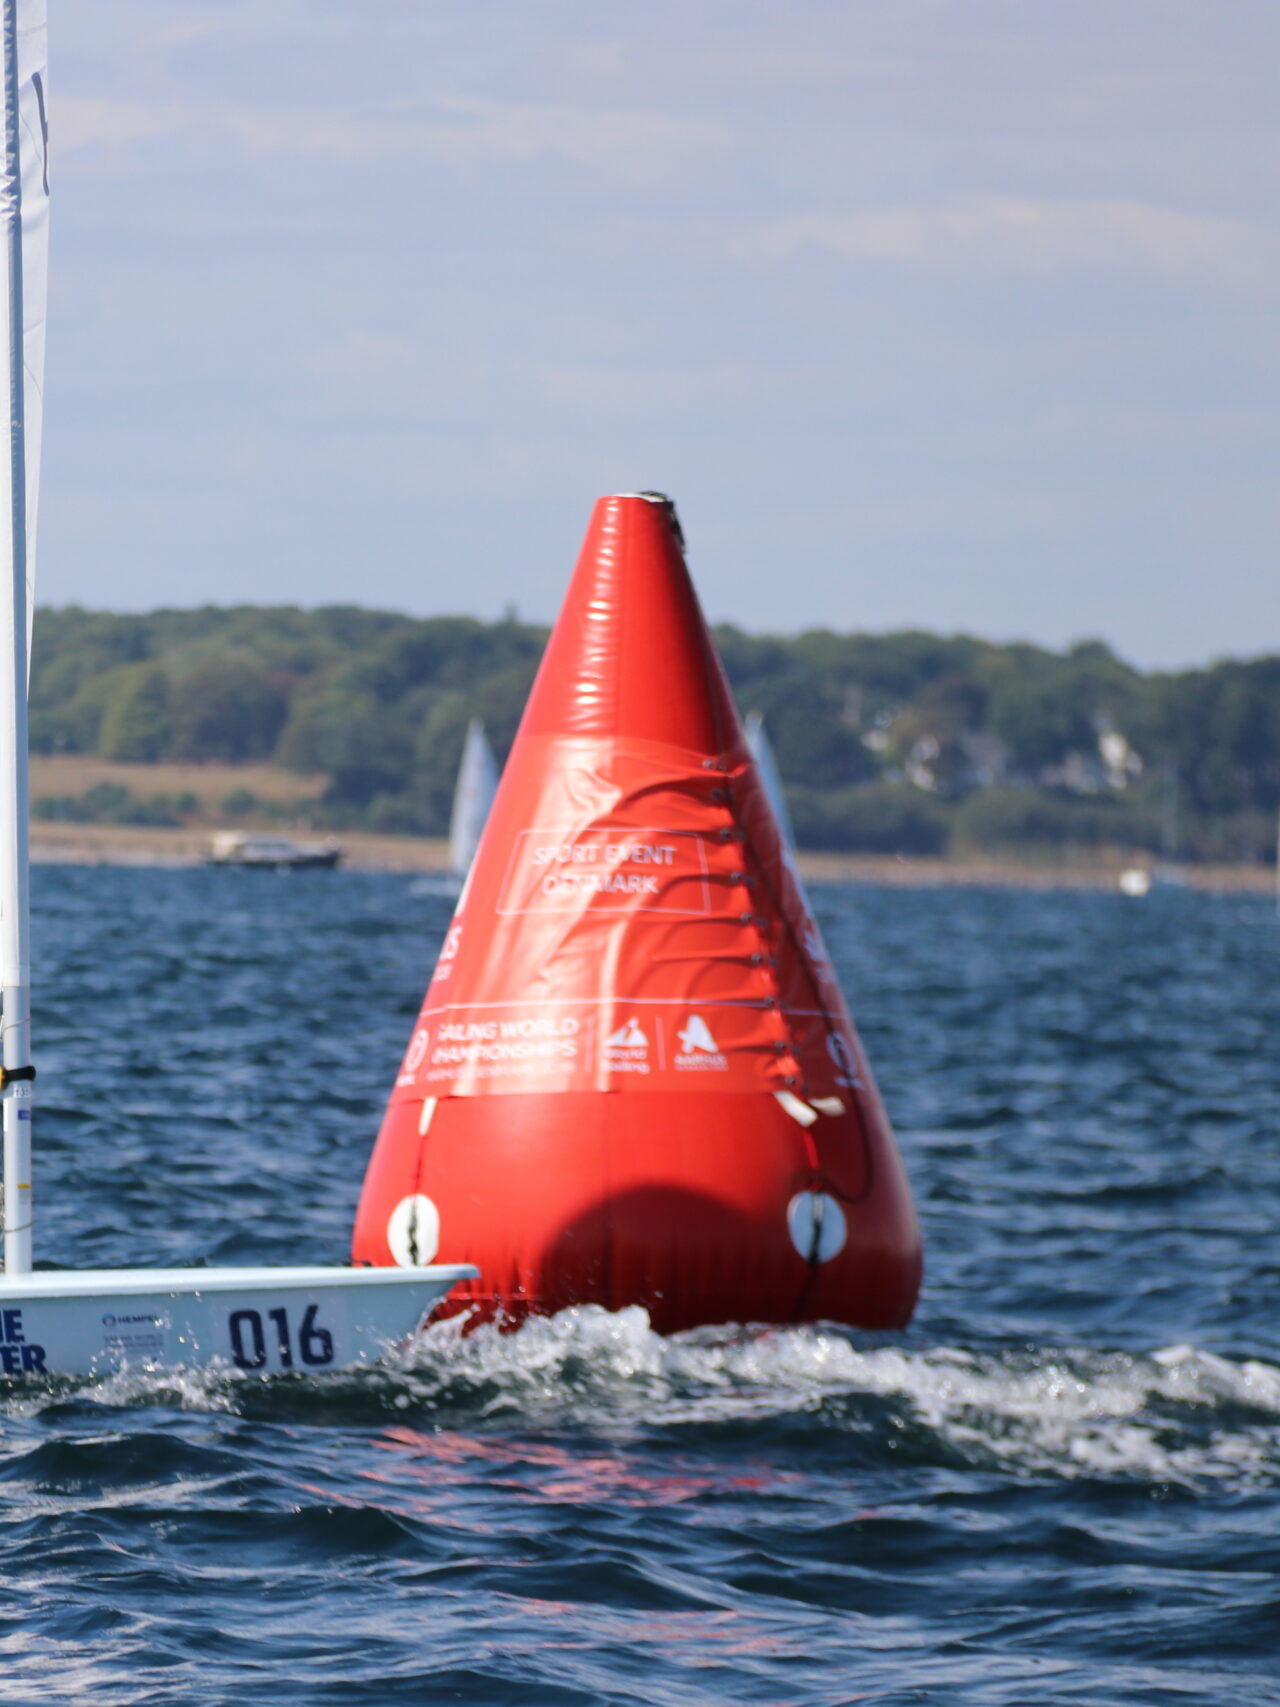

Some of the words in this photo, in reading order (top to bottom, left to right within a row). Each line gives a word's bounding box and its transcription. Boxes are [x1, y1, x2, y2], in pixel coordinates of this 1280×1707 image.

[532, 845, 599, 865] SPORT
[604, 844, 677, 865] EVENT
[500, 1018, 580, 1038] WORLD
[228, 1304, 335, 1370] 016
